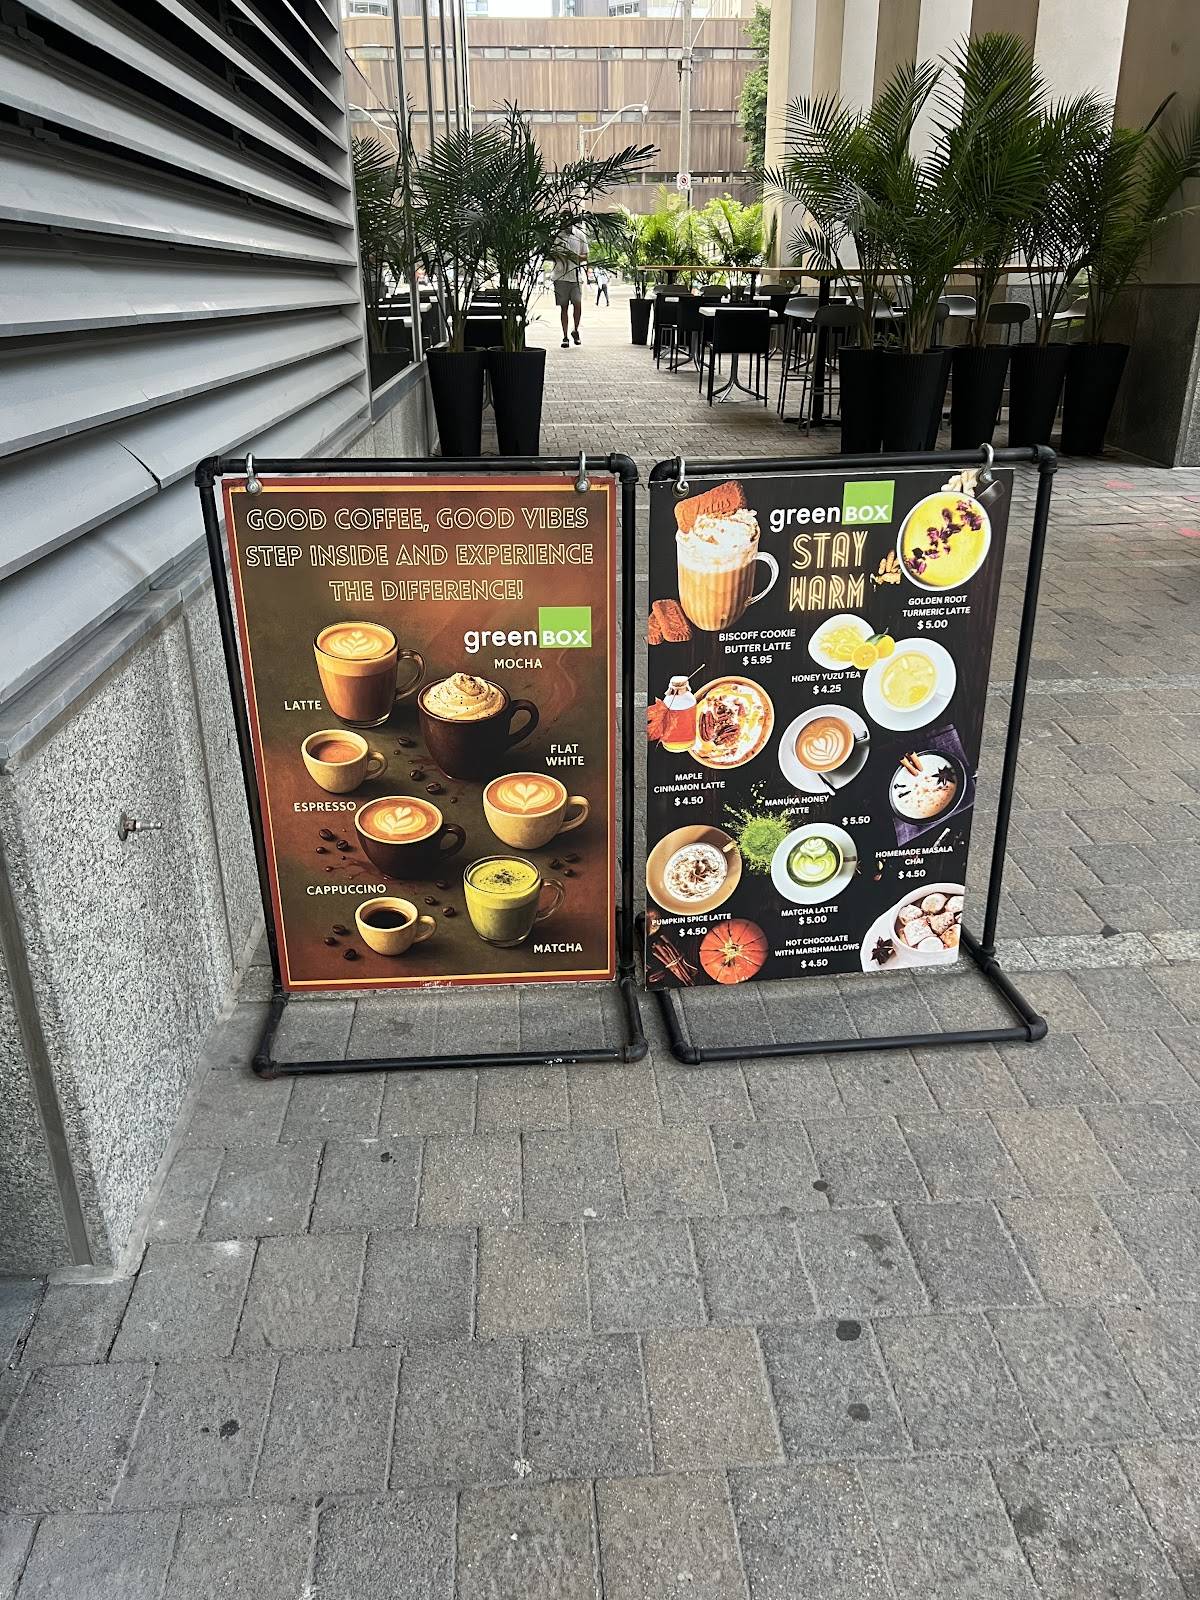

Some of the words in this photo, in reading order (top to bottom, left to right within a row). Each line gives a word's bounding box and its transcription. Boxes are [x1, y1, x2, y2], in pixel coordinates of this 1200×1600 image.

[247, 508, 327, 530] GOOD
[334, 508, 429, 532] COFFEE,
[437, 508, 514, 529] GOOD
[522, 508, 588, 529] VIBES
[246, 545, 302, 567] STEP
[310, 545, 388, 566] INSIDE
[396, 544, 448, 565] AND
[456, 543, 593, 565] EXPERIENCE
[792, 531, 868, 569] STAY
[329, 581, 374, 601] THE
[381, 580, 523, 601] DIFFERENCE!
[789, 573, 865, 612] WARM
[908, 596, 944, 605] GOLDEN
[945, 595, 967, 604] ROOT
[902, 607, 945, 617] TURMERIC
[946, 606, 970, 615] LATTE
[719, 630, 759, 642] BISCOFF
[760, 629, 796, 640] COOKIE
[725, 643, 760, 654] BUTTER
[762, 641, 791, 652] LATTE
[494, 658, 542, 669] MOCHA
[792, 673, 820, 683] HONEY
[821, 672, 843, 681] YUZU
[843, 671, 861, 680] TEA
[284, 700, 322, 711] LATTE
[550, 744, 578, 754] FLAT
[545, 756, 585, 766] WHITE
[675, 773, 703, 781] MAPLE
[654, 783, 699, 793] CINNAMON
[700, 781, 725, 790] LATTE
[765, 796, 799, 806] MANUKA
[800, 794, 829, 804] HONEY
[294, 802, 356, 812] ESPRESSO
[785, 806, 809, 815] LATTE
[875, 848, 921, 858] HOMEMADE
[921, 845, 953, 856] MASALA
[905, 857, 924, 866] CHAI
[306, 884, 386, 895] CAPPUCCINO
[781, 908, 813, 917] MATCHA
[814, 906, 838, 915] LATTE
[652, 917, 685, 926] PUMPKIN
[686, 915, 708, 924] SPICE
[709, 913, 731, 922] LATTE
[785, 938, 802, 947] HOT
[802, 935, 848, 946] CHOCOLATE
[534, 943, 583, 953] MATCHA
[775, 948, 794, 957] WITH
[796, 943, 859, 955] MARSHMALLOWS
